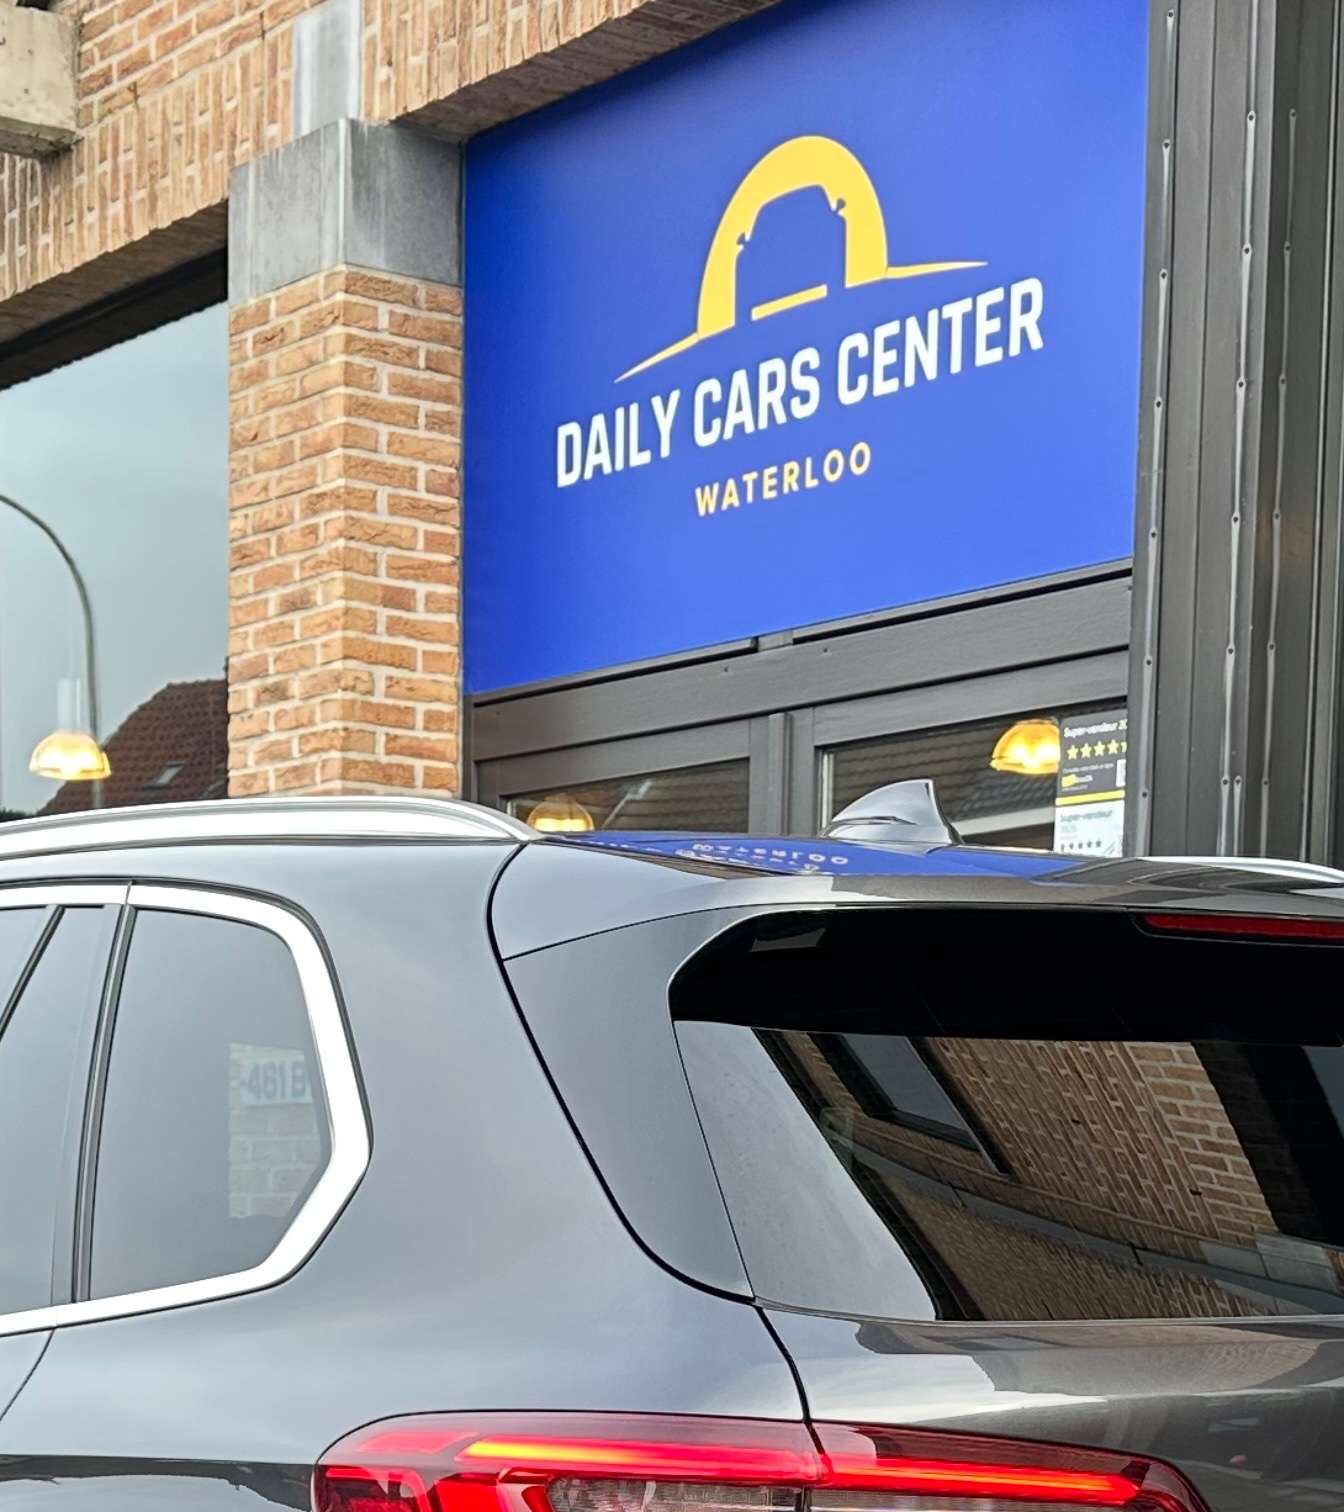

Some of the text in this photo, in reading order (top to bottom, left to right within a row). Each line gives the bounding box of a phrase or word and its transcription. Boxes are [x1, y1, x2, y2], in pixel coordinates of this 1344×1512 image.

[556, 277, 1045, 489] DAILY CARS CENTER
[695, 441, 872, 517] WATERLOO
